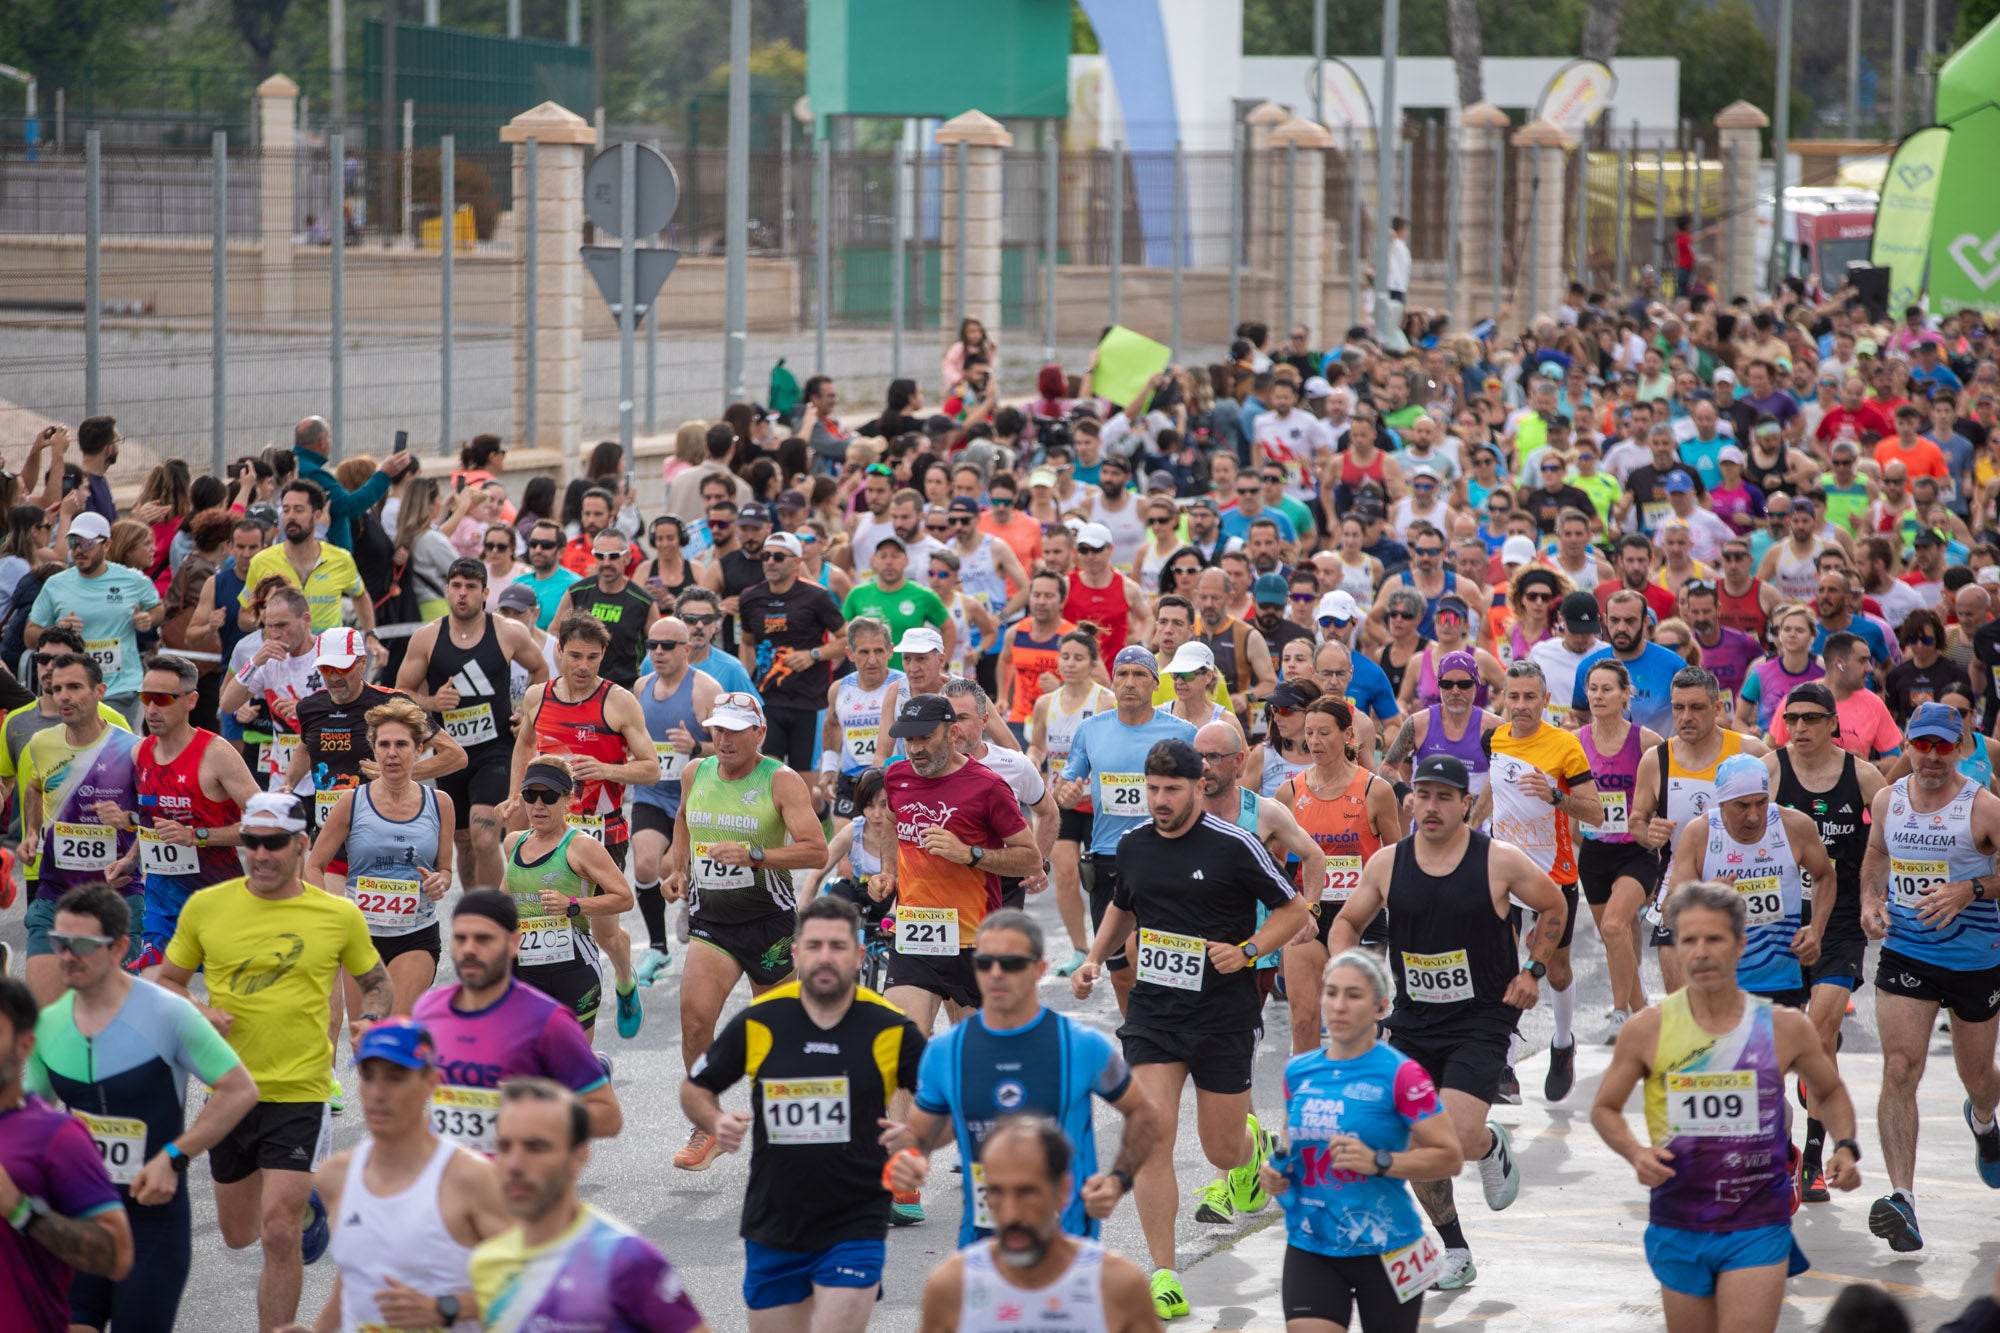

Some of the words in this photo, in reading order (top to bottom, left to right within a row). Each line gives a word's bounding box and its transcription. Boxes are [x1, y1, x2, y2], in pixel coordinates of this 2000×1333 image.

[87, 651, 113, 664] 59
[447, 716, 493, 737] 3072
[843, 716, 880, 728] MARACE
[320, 740, 351, 751] 2025
[260, 749, 271, 762] 2
[1116, 776, 1145, 784] FONDO
[159, 795, 192, 808] SEUR
[1115, 788, 1141, 805] 28
[321, 806, 333, 819] 8
[687, 810, 712, 824] TEAM
[62, 824, 71, 834] 38
[71, 826, 103, 836] FONDO
[1822, 820, 1855, 836] PÚBLICA
[1892, 832, 1956, 847] MARACENA
[62, 839, 106, 858] 268
[151, 845, 178, 863] 10
[376, 856, 394, 865] RUN
[1903, 863, 1935, 872] FONDO
[1324, 871, 1360, 889] 22
[1716, 864, 1784, 880] MARACENA
[365, 879, 375, 888] 38
[375, 882, 407, 892] FONDO
[358, 894, 417, 914] 2242
[904, 909, 914, 919] 38
[914, 911, 945, 920] FONDO
[529, 920, 558, 930] FONDO
[905, 924, 946, 942] 221
[520, 929, 570, 950] 2205
[1149, 932, 1158, 942] 38
[1158, 937, 1191, 949] FONDO
[1140, 947, 1200, 976] 3035
[1419, 956, 1453, 967] FONDO
[1408, 968, 1468, 990] 3068
[1680, 1077, 1693, 1088] 38
[768, 1101, 846, 1128] 1014
[1302, 1099, 1345, 1116] ADRA
[1683, 1094, 1743, 1120] 109
[434, 1109, 497, 1137] 333
[1301, 1114, 1340, 1130] TRAIL
